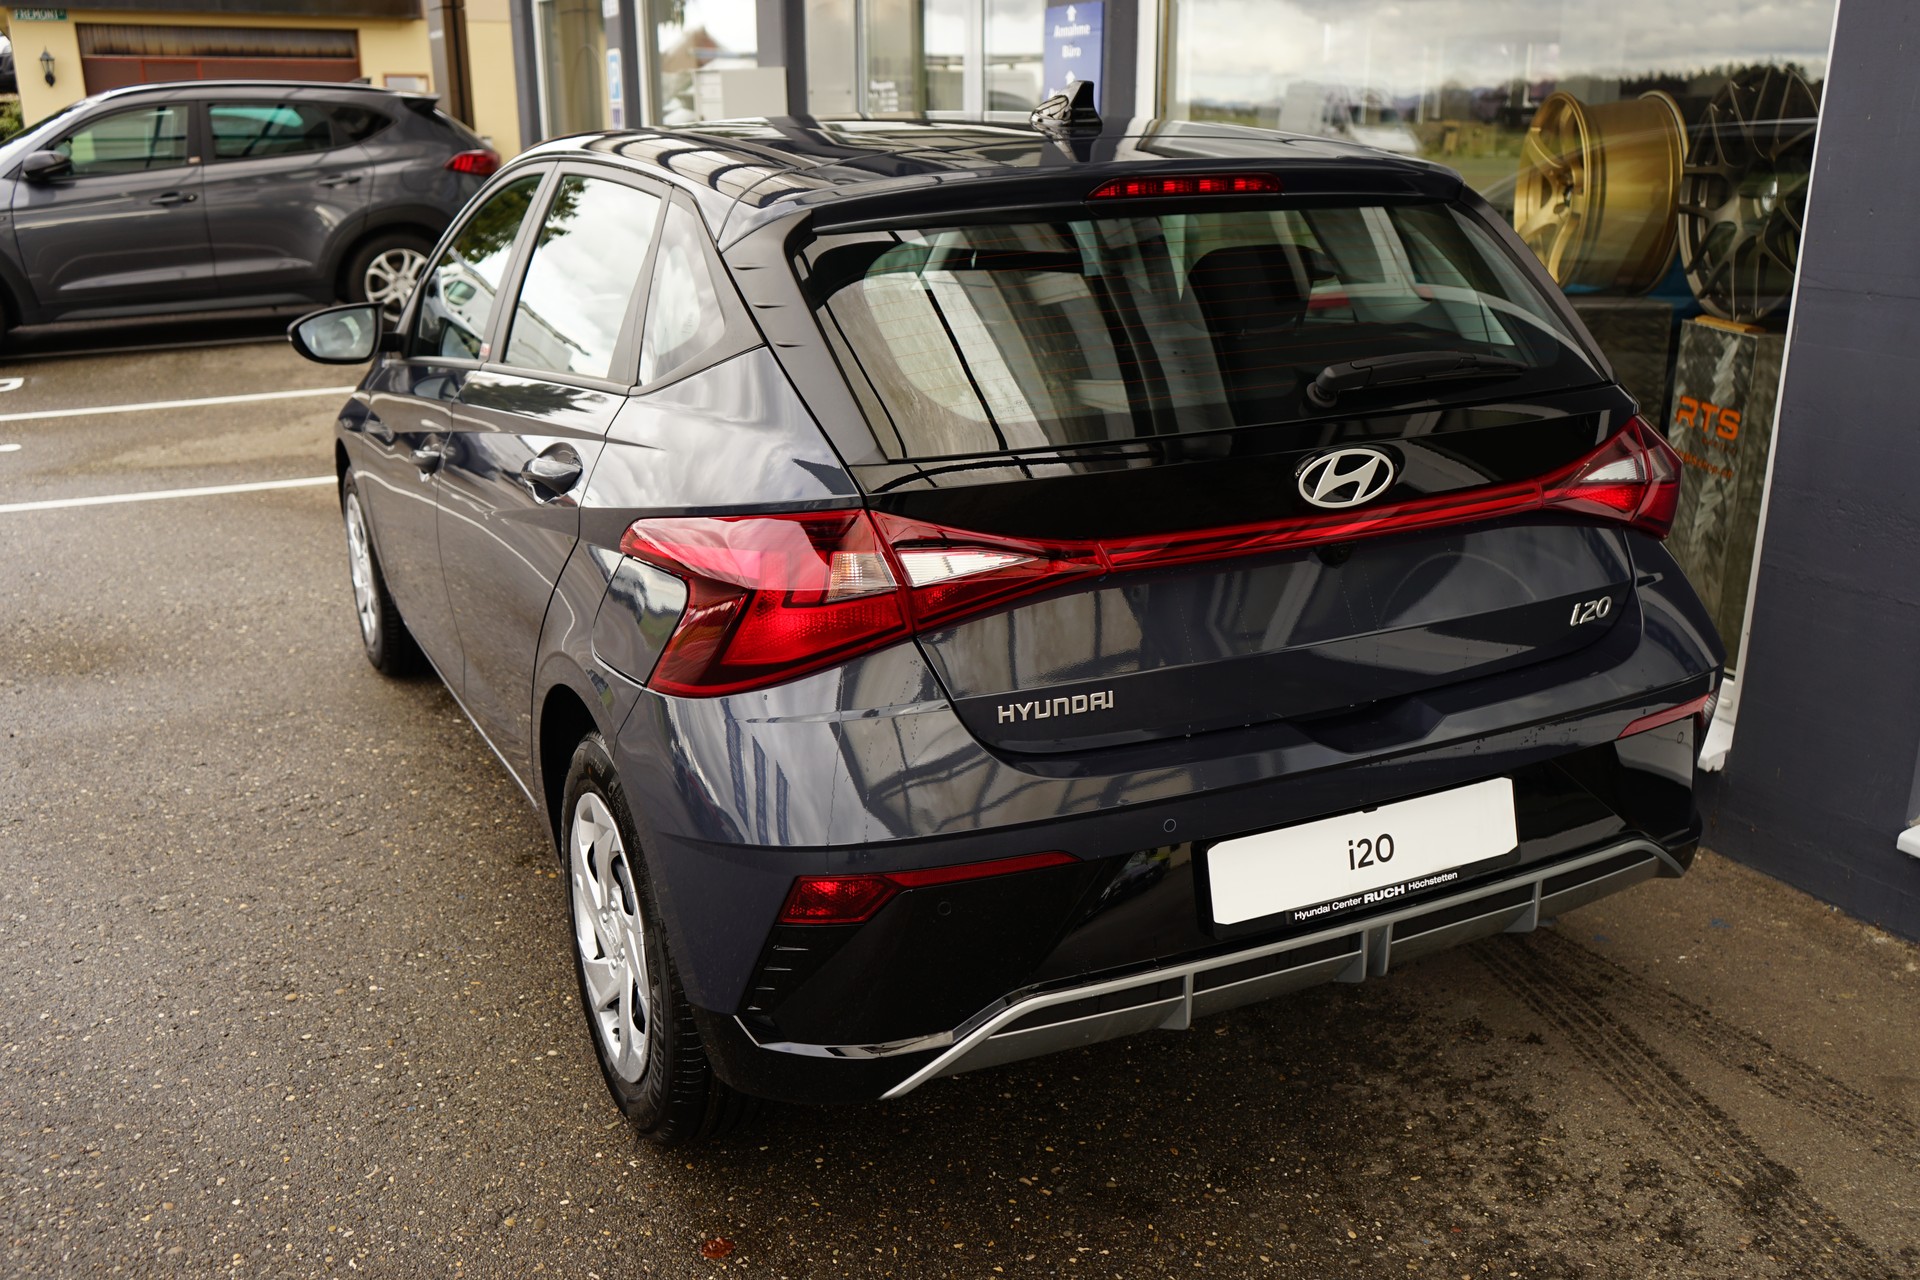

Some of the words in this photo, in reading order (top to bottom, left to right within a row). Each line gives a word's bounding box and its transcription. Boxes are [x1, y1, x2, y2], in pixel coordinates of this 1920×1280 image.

[1053, 23, 1091, 38] Annahme
[1676, 395, 1741, 440] RTS
[1570, 596, 1612, 626] i20
[997, 690, 1114, 724] HYUNDAI
[1348, 833, 1394, 870] i20
[1294, 903, 1331, 920] Hyundai
[1332, 897, 1362, 910] Center
[1363, 884, 1406, 904] RUCH
[1408, 872, 1458, 891] Höchstetten
